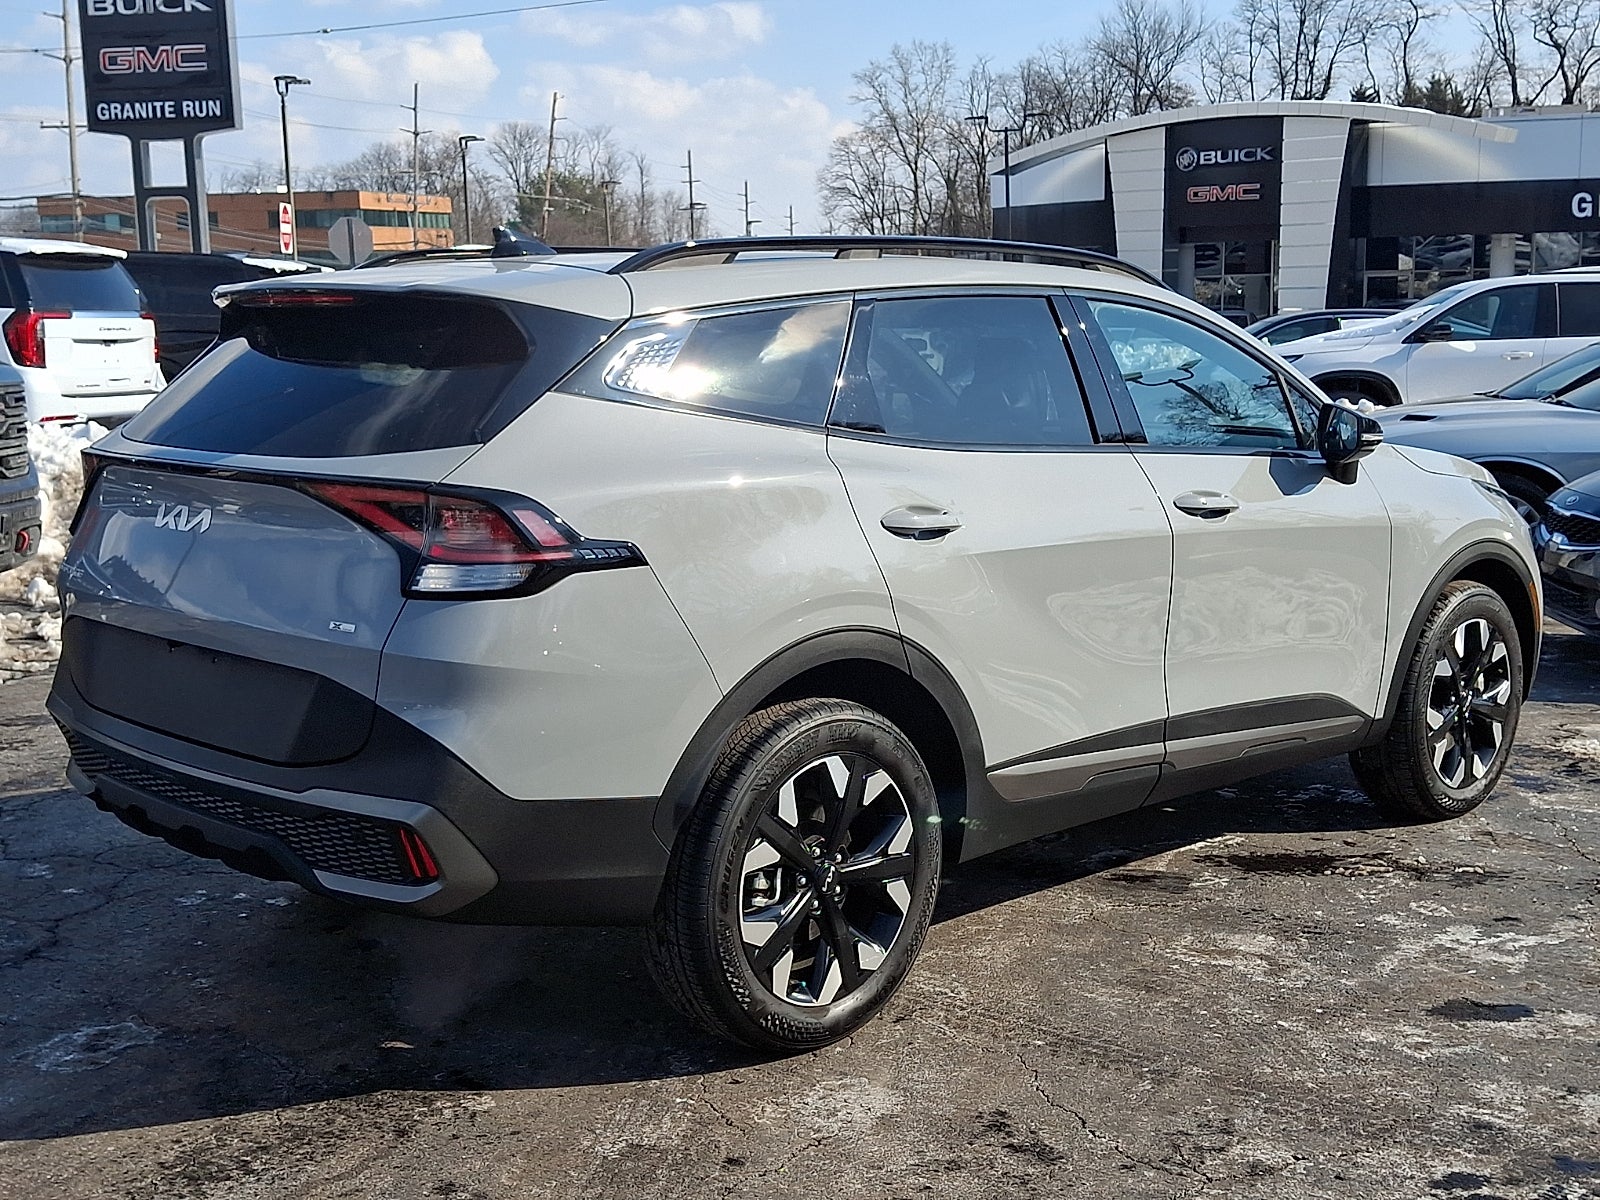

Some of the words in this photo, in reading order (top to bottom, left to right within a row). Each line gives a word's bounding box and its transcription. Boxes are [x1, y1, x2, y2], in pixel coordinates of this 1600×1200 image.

[87, 0, 212, 16] BUICK
[100, 44, 207, 74] GMC
[97, 101, 176, 121] GRANITE
[182, 100, 221, 118] RUN
[1200, 146, 1274, 165] BUICK
[1187, 183, 1260, 203] GMC
[1571, 192, 1600, 218] G
[155, 503, 212, 534] KIA
